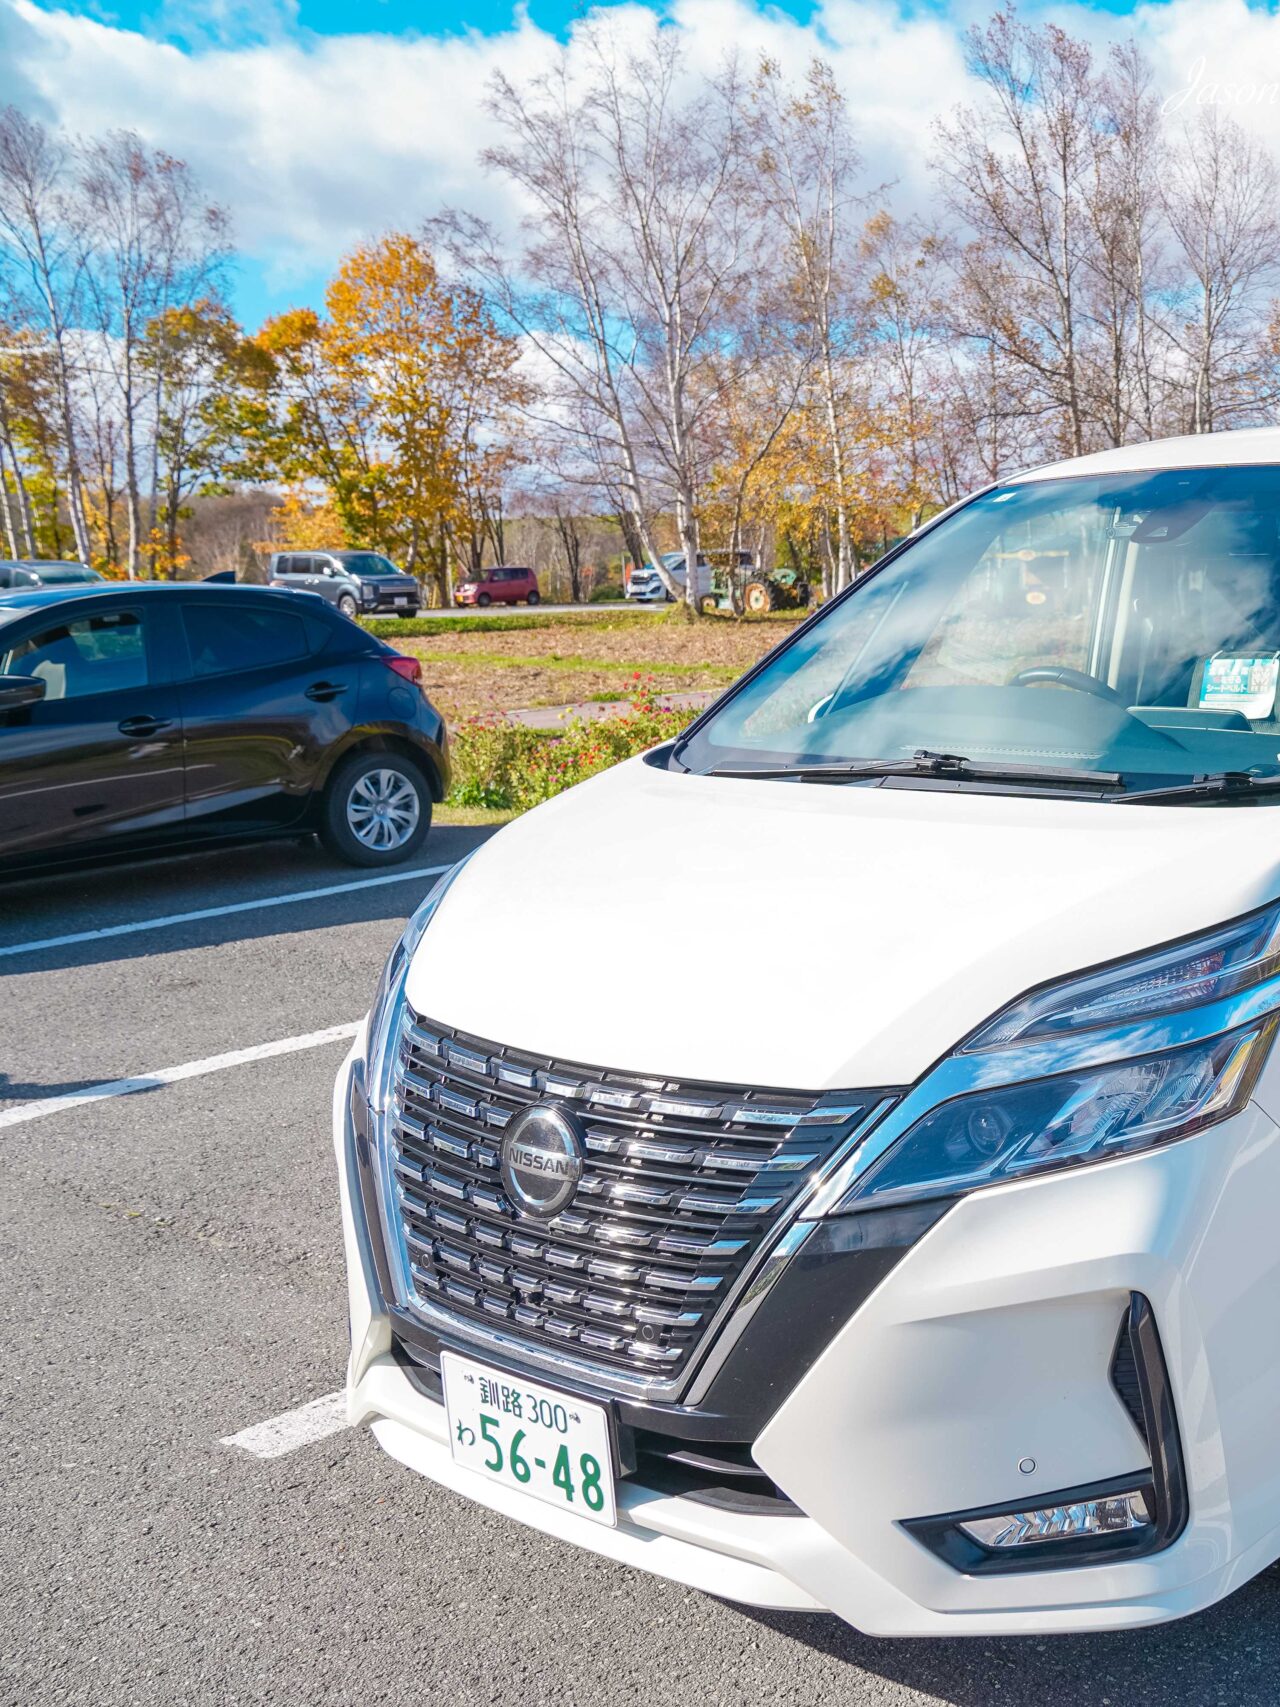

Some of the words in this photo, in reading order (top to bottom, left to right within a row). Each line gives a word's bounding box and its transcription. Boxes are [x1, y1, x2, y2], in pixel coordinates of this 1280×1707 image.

[509, 1147, 569, 1176] NISSAN
[456, 1418, 476, 1446] わ
[479, 1413, 604, 1512] 56-48
